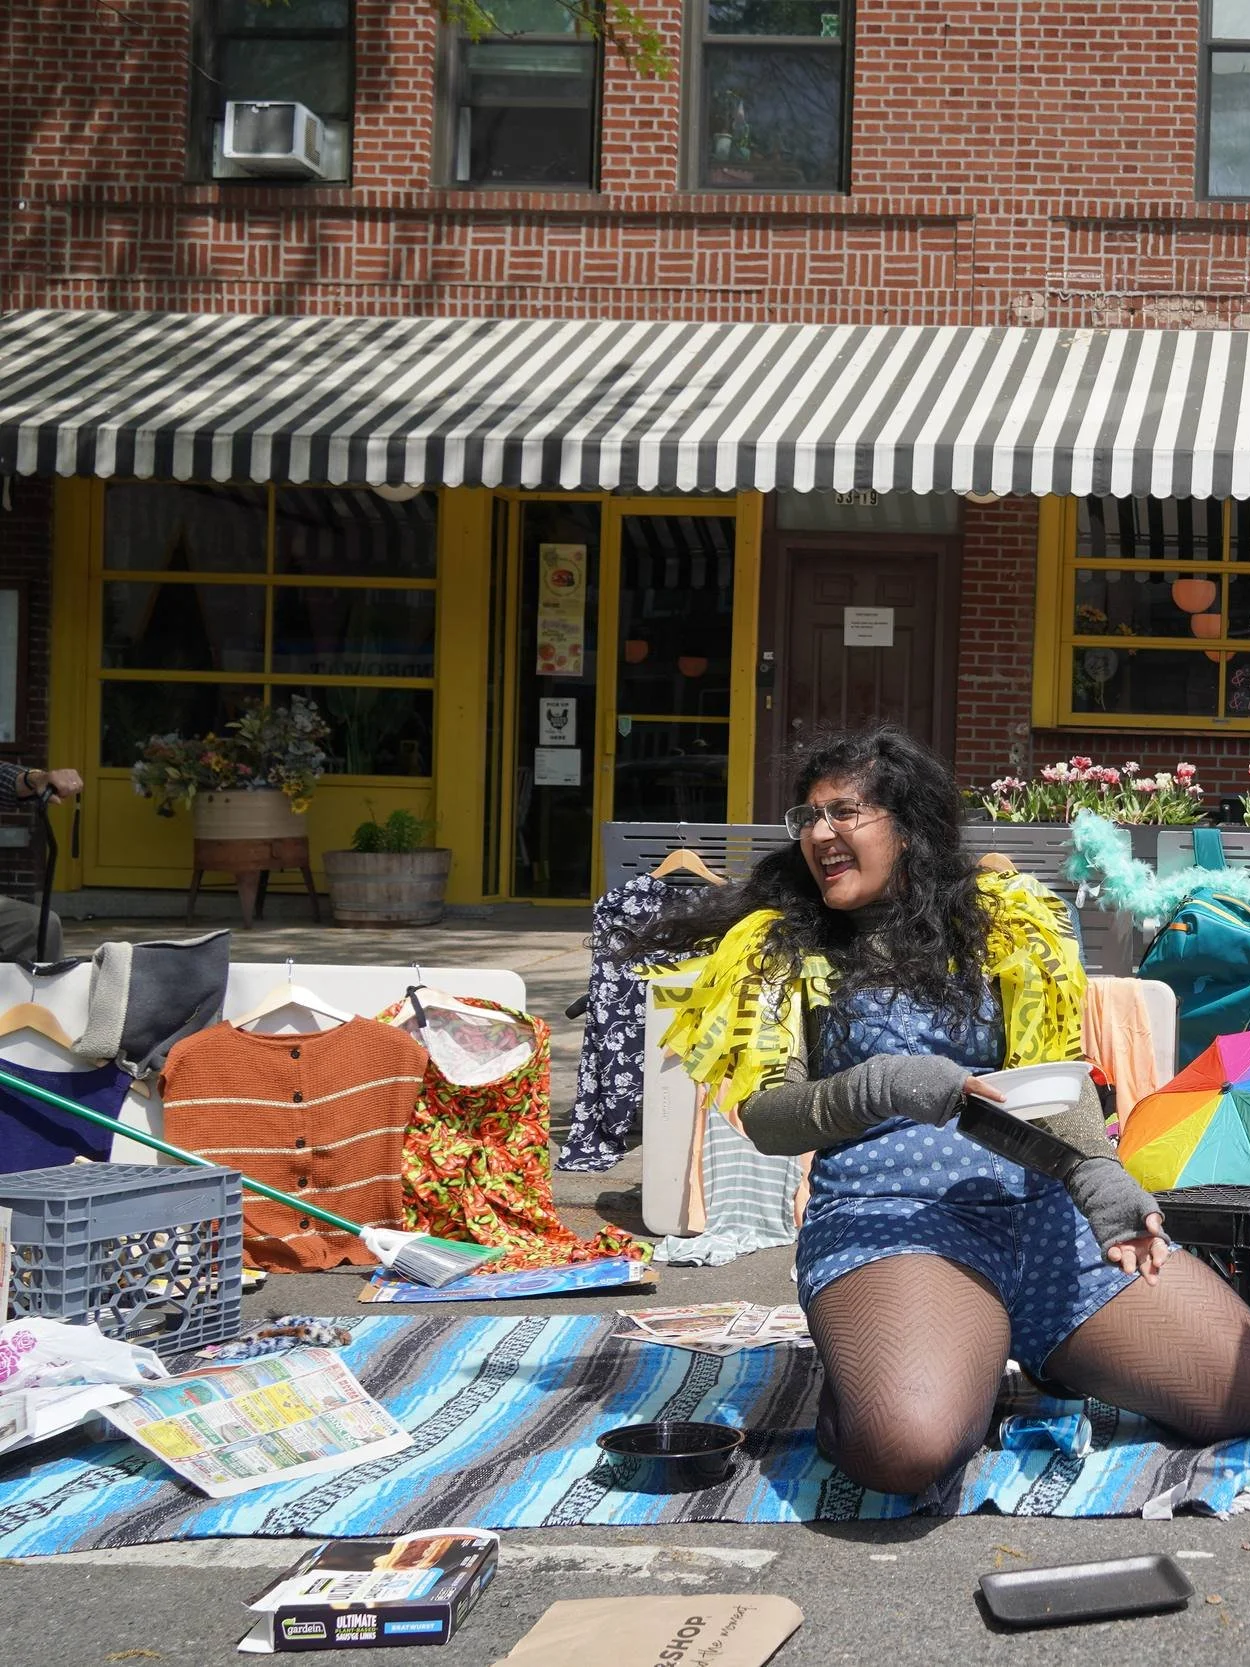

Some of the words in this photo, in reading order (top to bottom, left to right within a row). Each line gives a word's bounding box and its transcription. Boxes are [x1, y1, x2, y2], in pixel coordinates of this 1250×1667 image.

[336, 1614, 377, 1628] ULTIMATE
[391, 1622, 435, 1631] BRATWURST
[360, 1631, 376, 1640] LINKS
